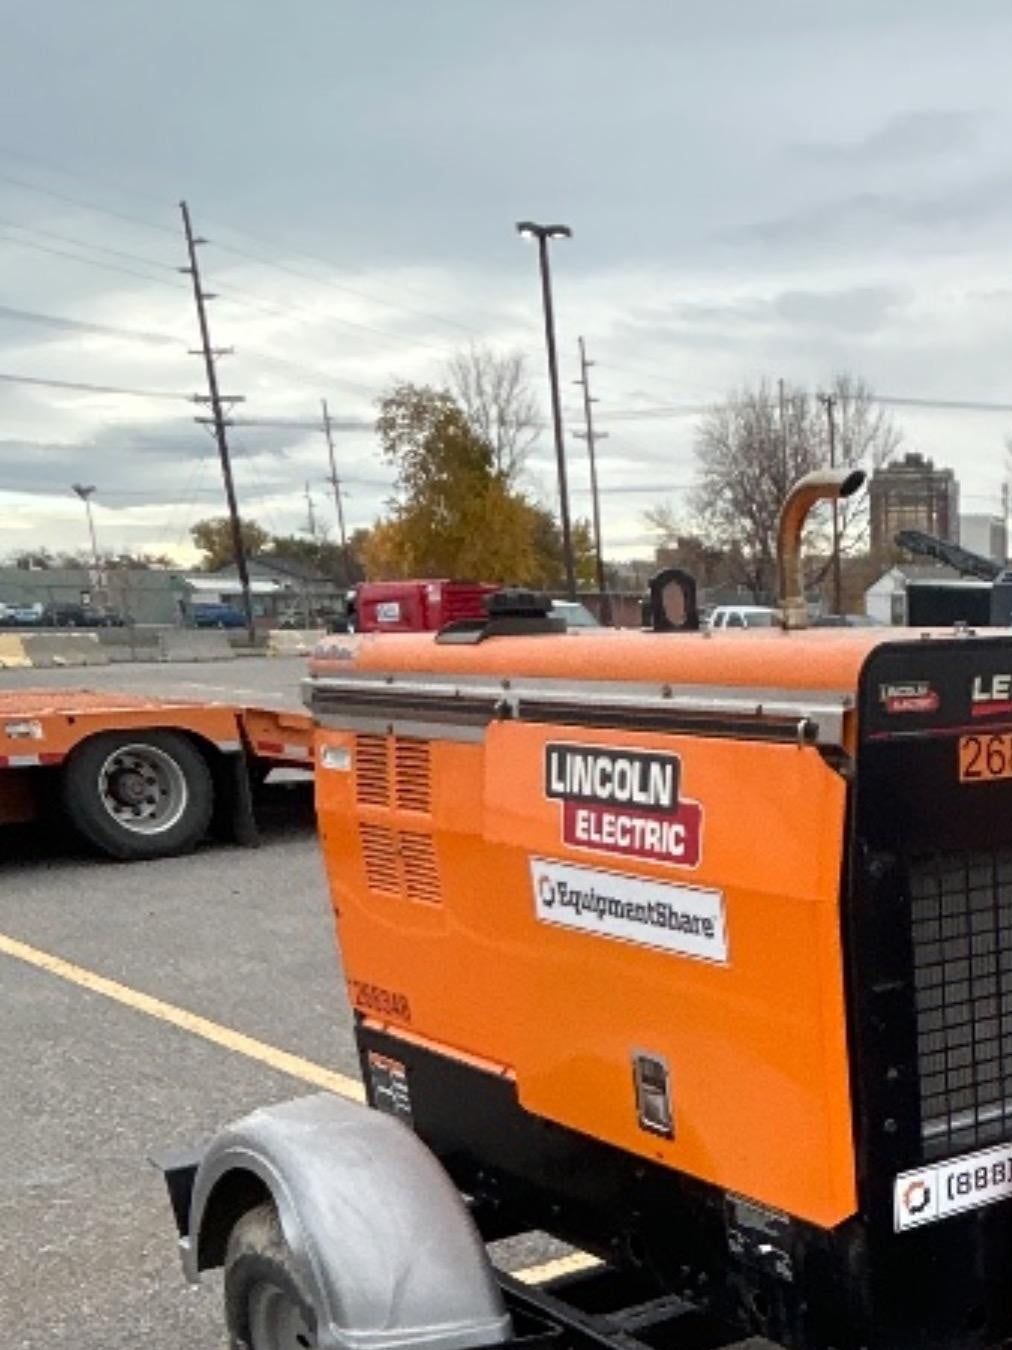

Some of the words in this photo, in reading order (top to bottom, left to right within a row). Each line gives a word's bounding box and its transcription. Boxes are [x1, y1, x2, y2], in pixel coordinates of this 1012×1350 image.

[550, 751, 674, 807] LINCOLN
[574, 809, 686, 856] ELECTRIC
[557, 881, 715, 939] EquipmentShare
